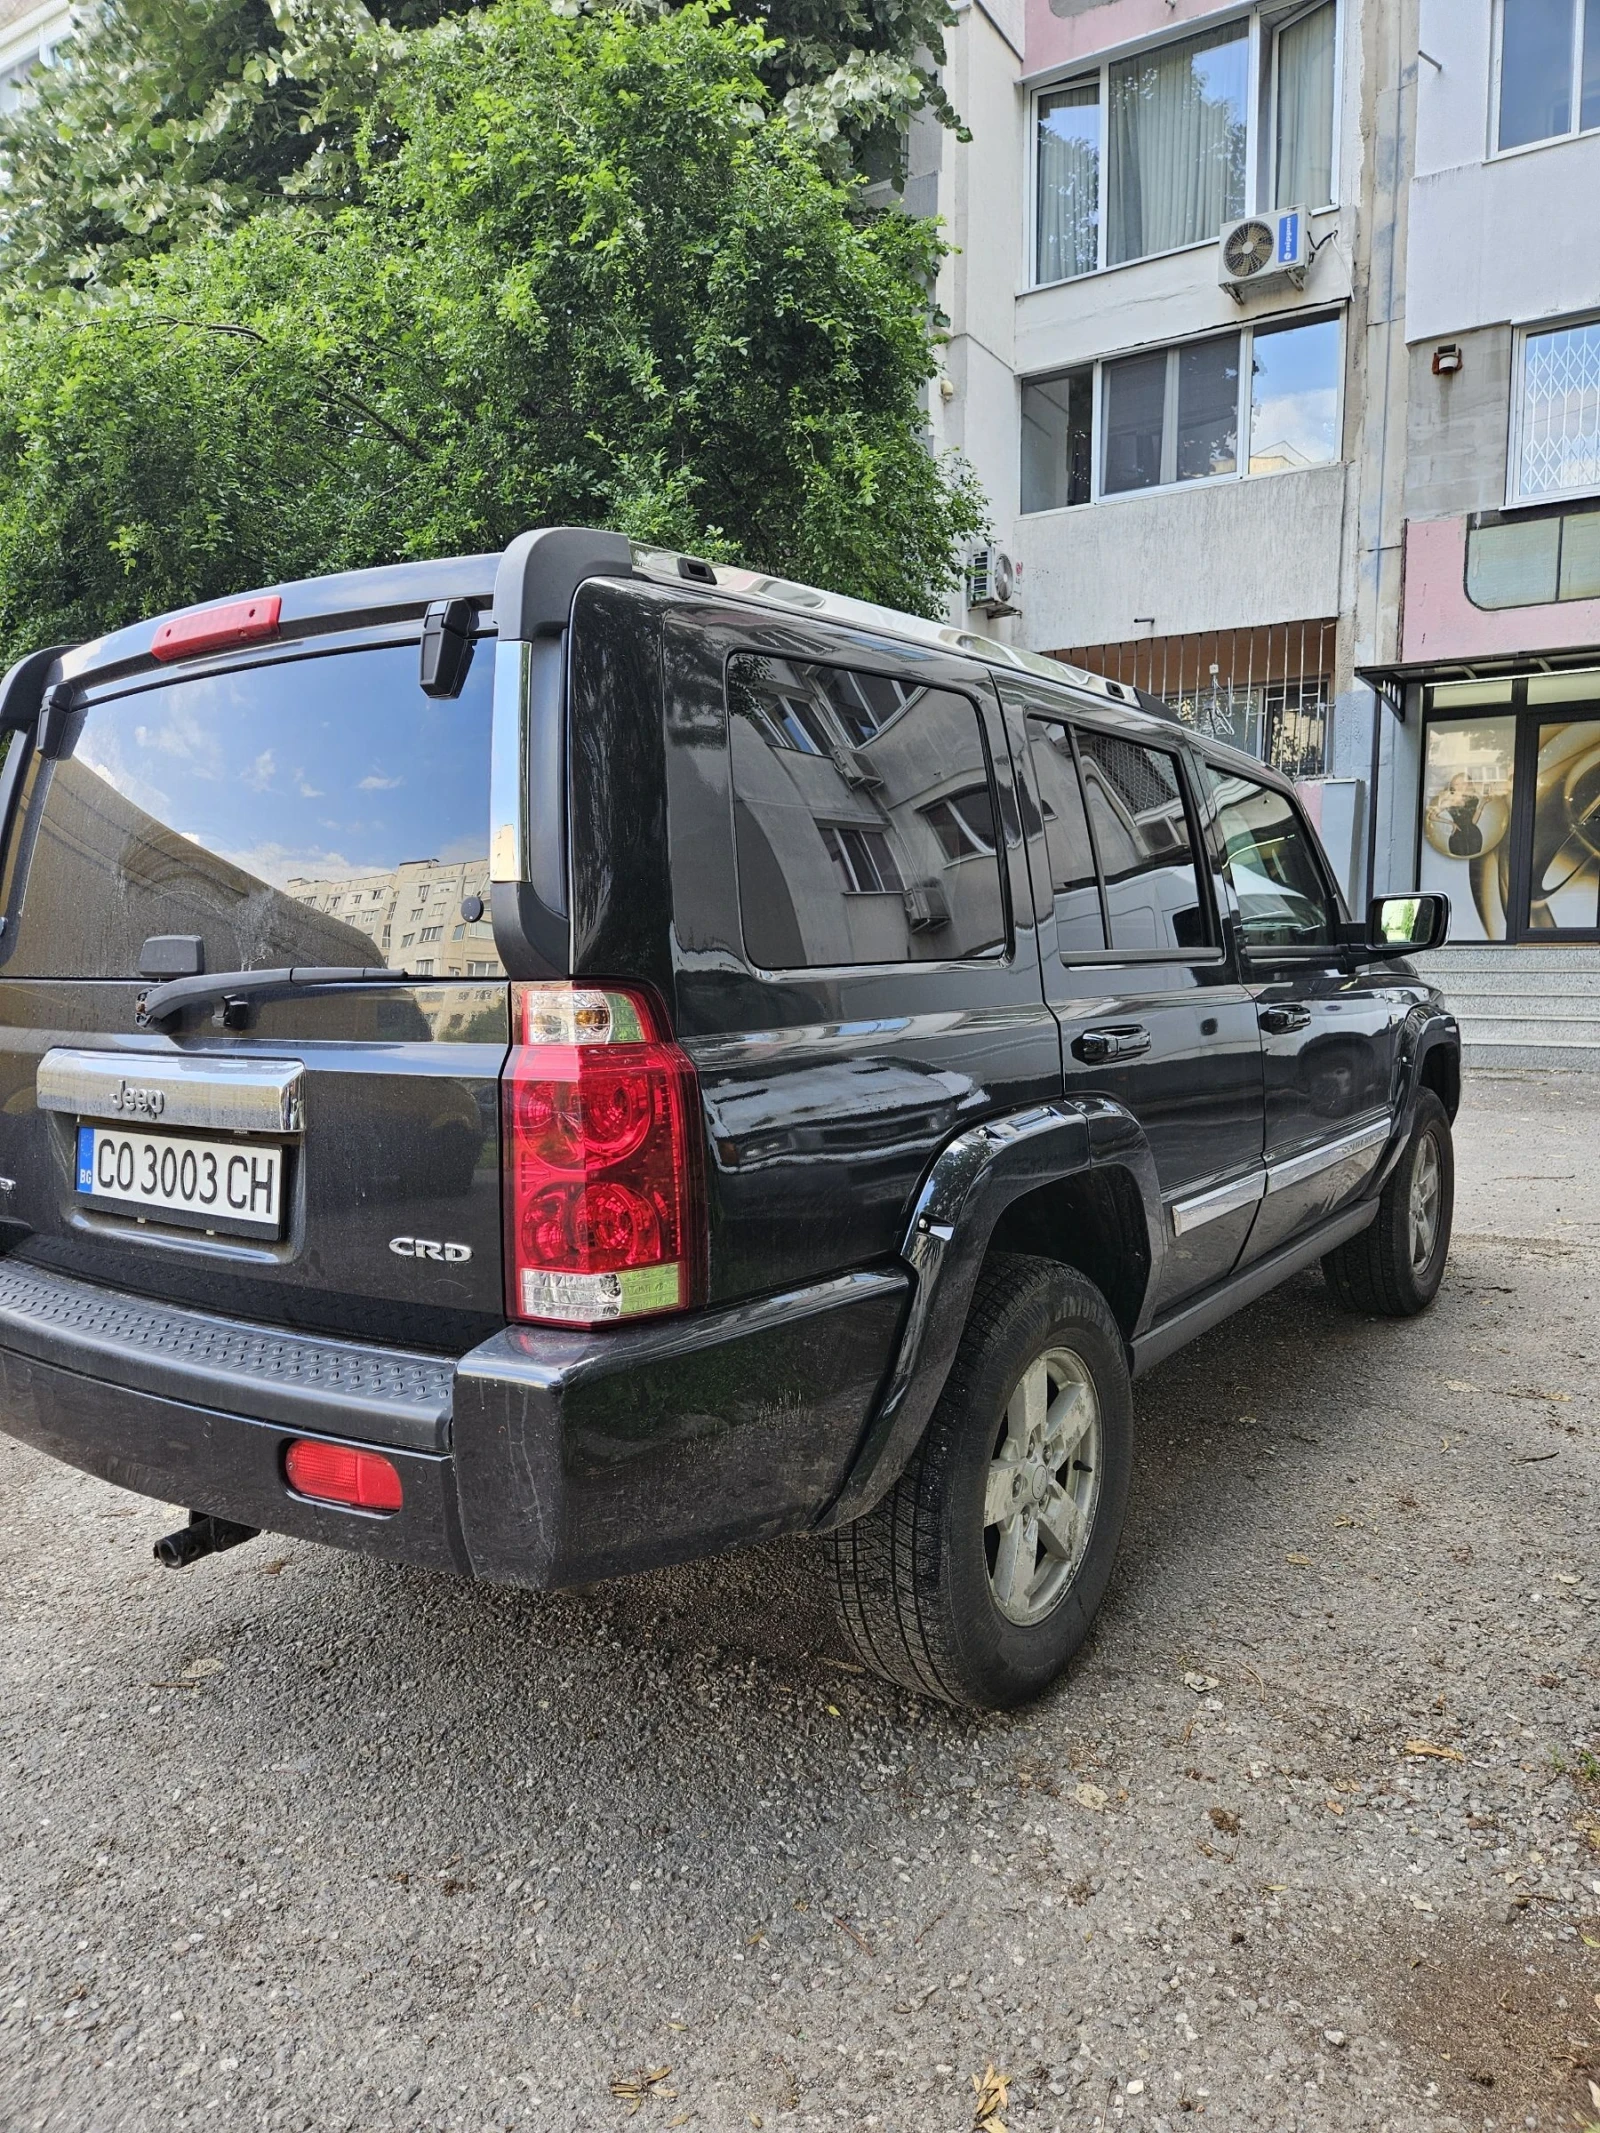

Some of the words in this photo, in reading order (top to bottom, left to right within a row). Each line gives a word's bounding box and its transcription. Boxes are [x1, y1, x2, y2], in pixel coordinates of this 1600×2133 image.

[109, 1079, 166, 1120] Jeep
[80, 1168, 92, 1185] BG
[97, 1138, 134, 1191] CO
[140, 1144, 218, 1204] 3003
[226, 1155, 273, 1214] CH
[388, 1237, 473, 1262] CRD
